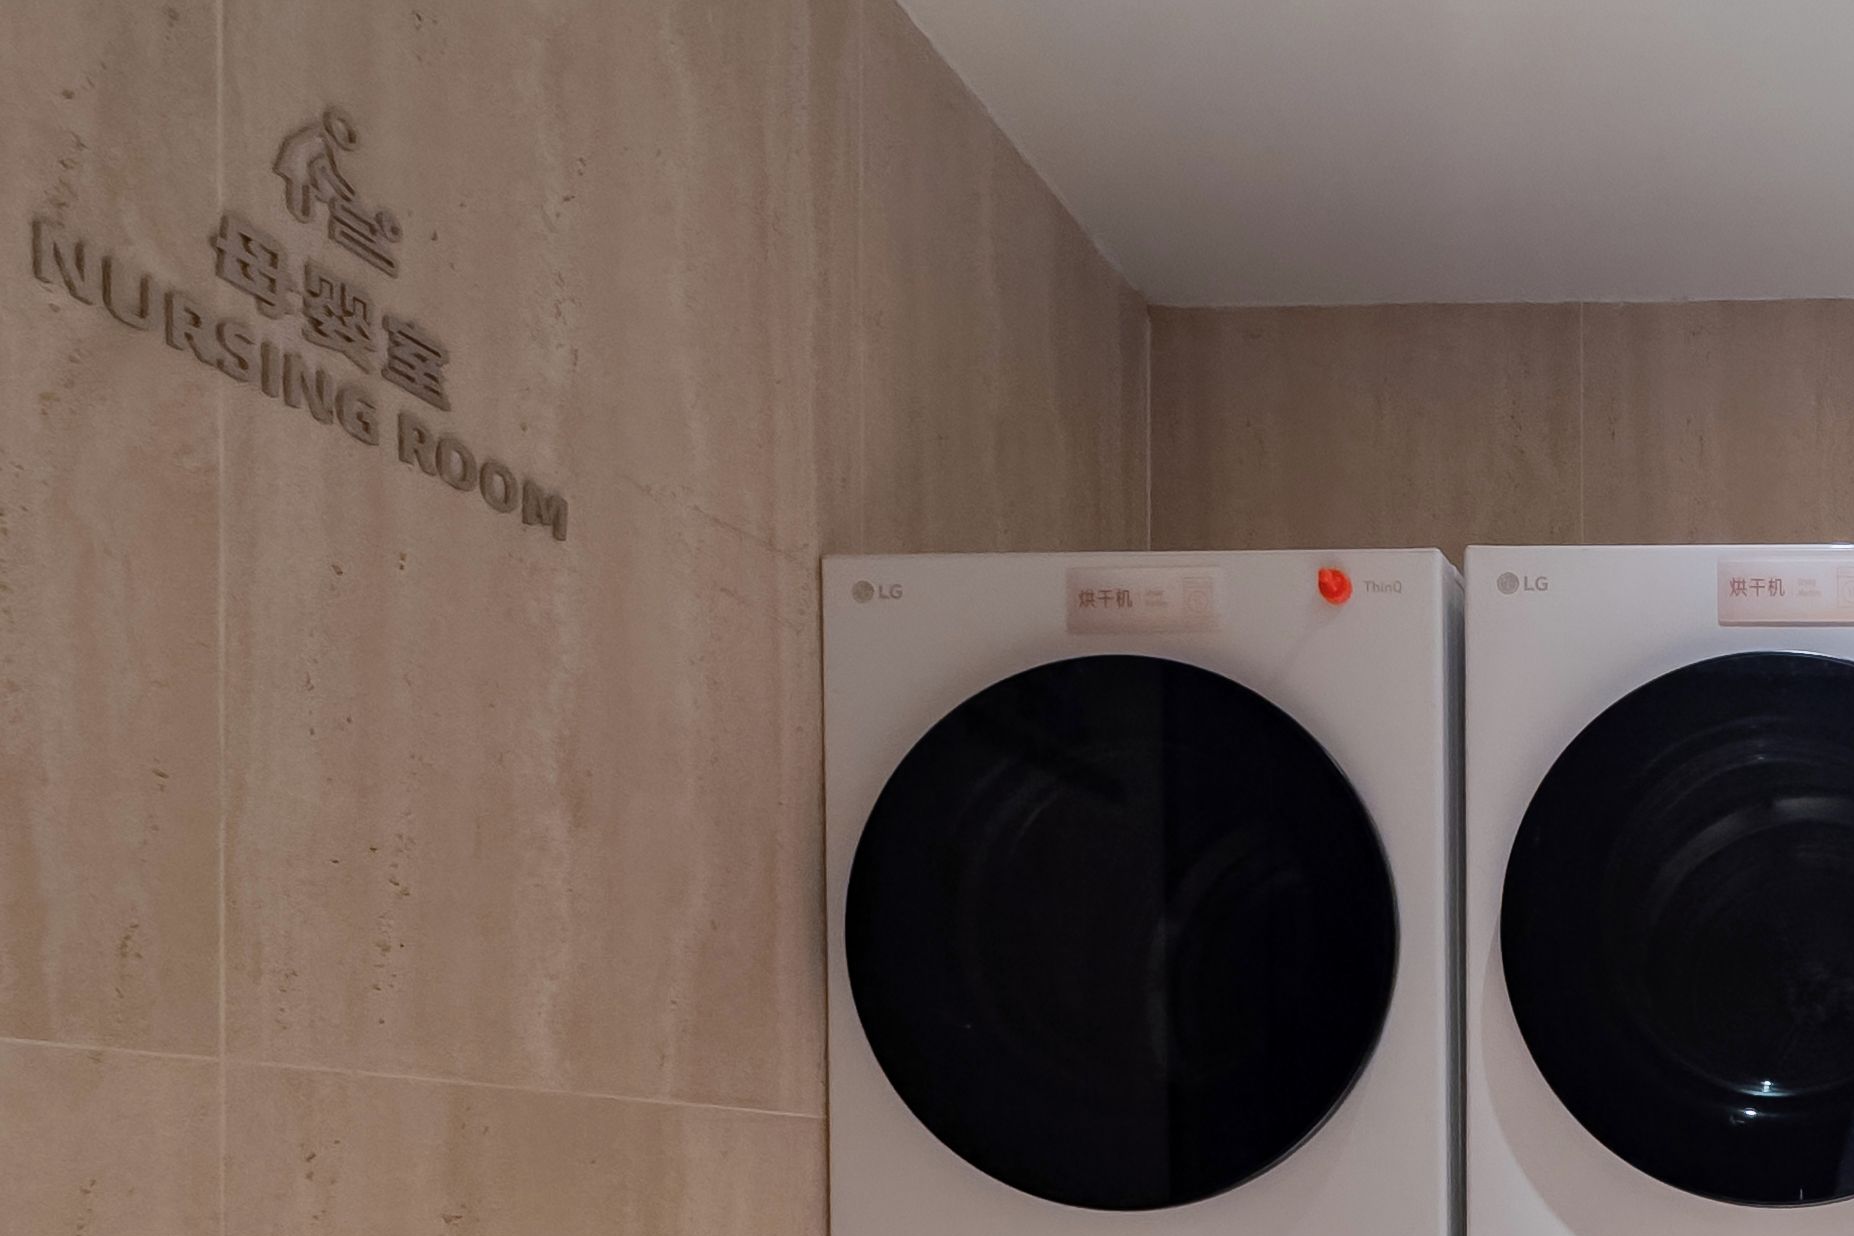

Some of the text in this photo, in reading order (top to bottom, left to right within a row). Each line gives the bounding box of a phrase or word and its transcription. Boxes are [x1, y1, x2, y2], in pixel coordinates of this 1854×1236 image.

[209, 211, 452, 412] 母婴室
[30, 215, 569, 542] NURSING ROOM
[878, 583, 904, 599] LG
[1362, 580, 1403, 594] ThinQ
[1523, 575, 1549, 592] LG
[1728, 576, 1786, 598] 烘干机
[1077, 588, 1133, 610] 烘干机
